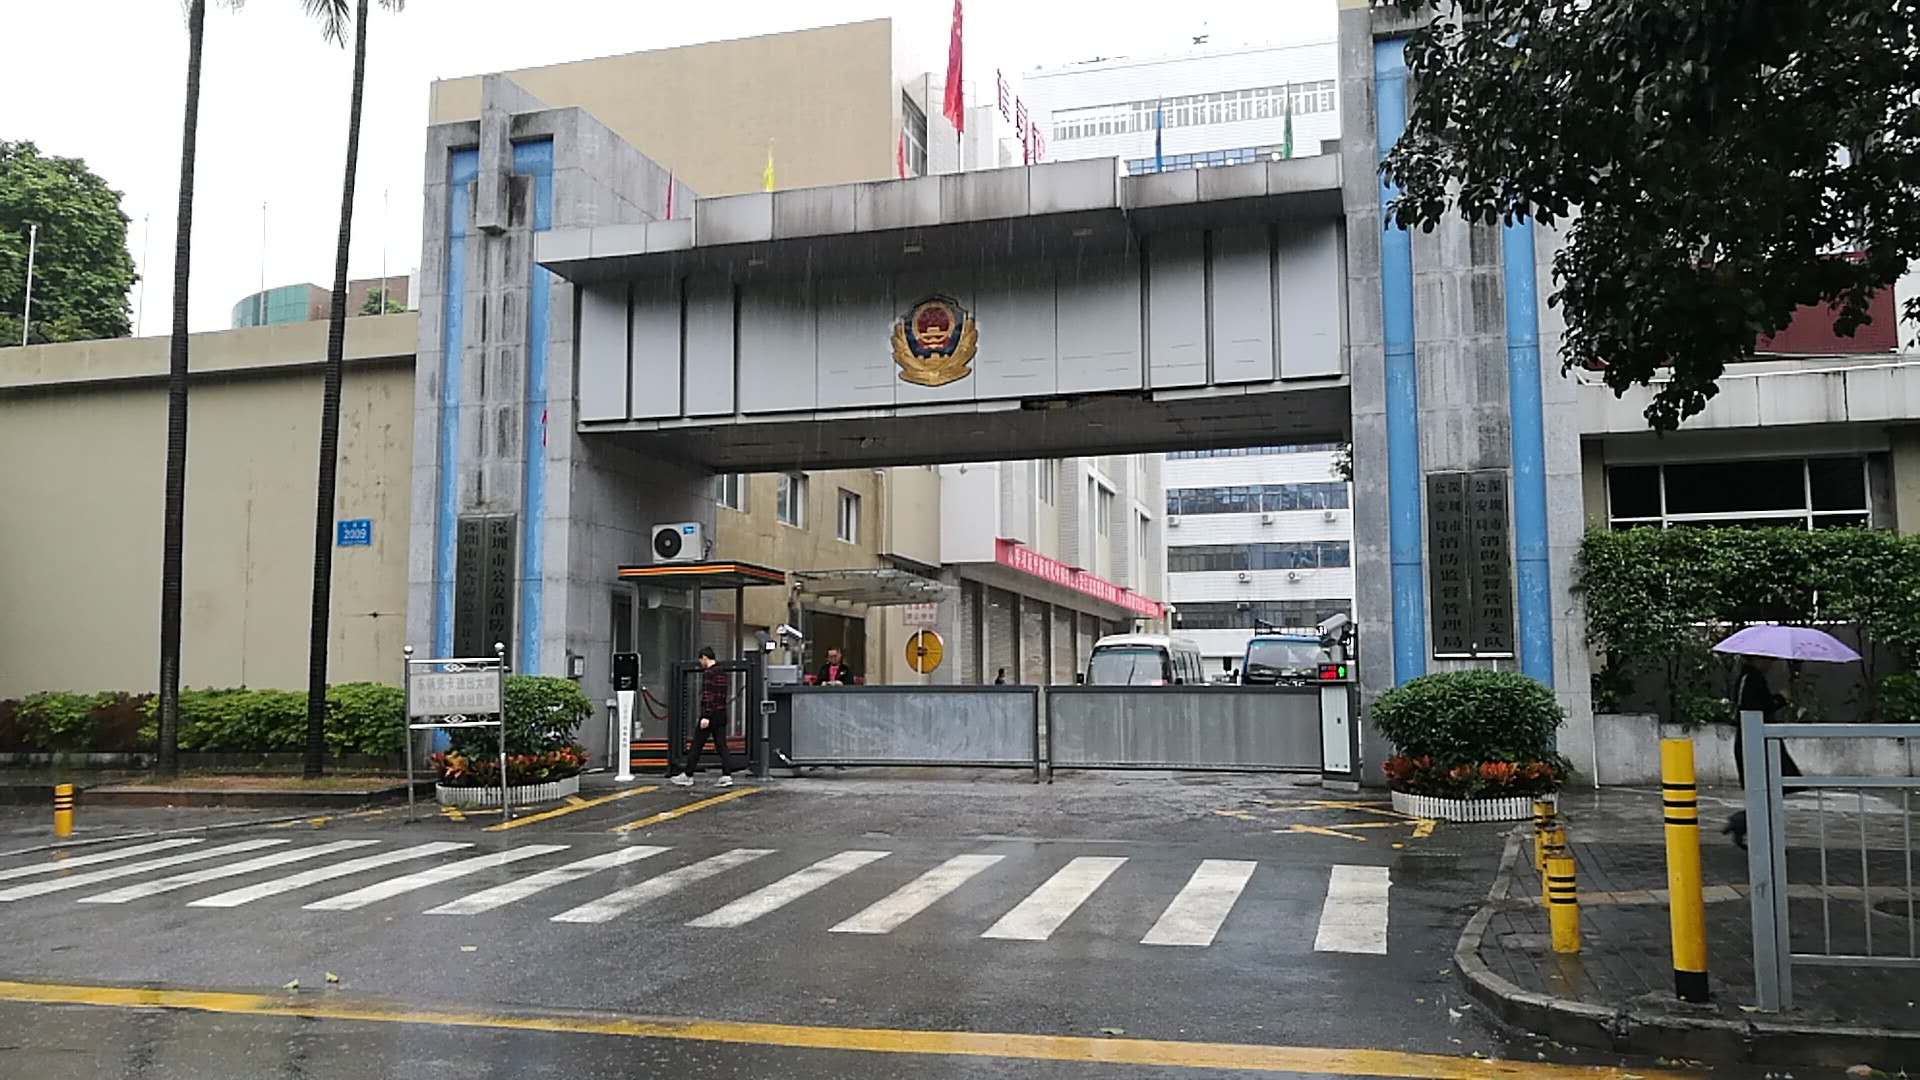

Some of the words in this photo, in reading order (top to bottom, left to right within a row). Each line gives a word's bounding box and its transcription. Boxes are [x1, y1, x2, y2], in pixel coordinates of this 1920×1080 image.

[488, 520, 508, 656] 深圳市公安消防
